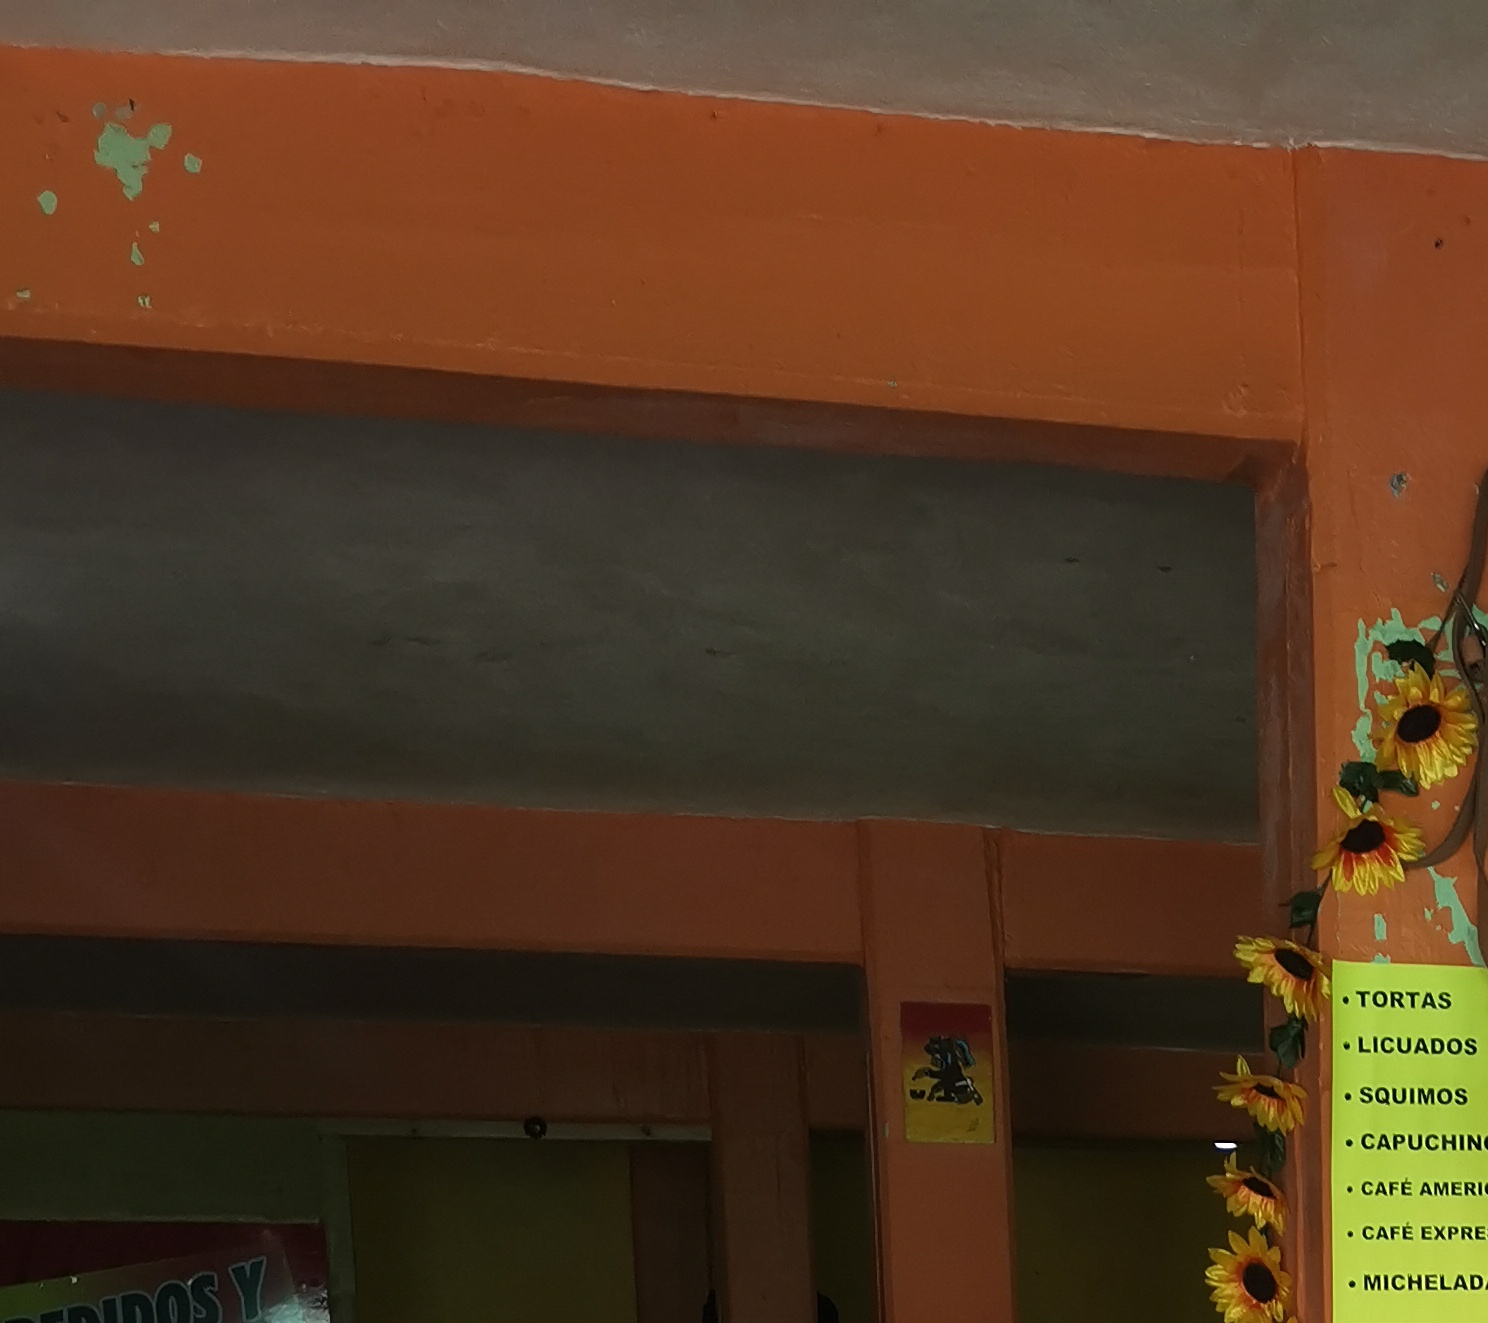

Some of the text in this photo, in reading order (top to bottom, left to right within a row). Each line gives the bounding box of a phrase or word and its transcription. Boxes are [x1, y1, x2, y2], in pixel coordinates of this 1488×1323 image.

[1355, 990, 1452, 1010] TORTAS
[1358, 1036, 1478, 1056] LICUADOS
[1359, 1086, 1468, 1107] SQUIMOS
[1361, 1177, 1412, 1197] CAFÉ
[1362, 1222, 1414, 1241] CAFÉ
[228, 1256, 266, 1322] Y
